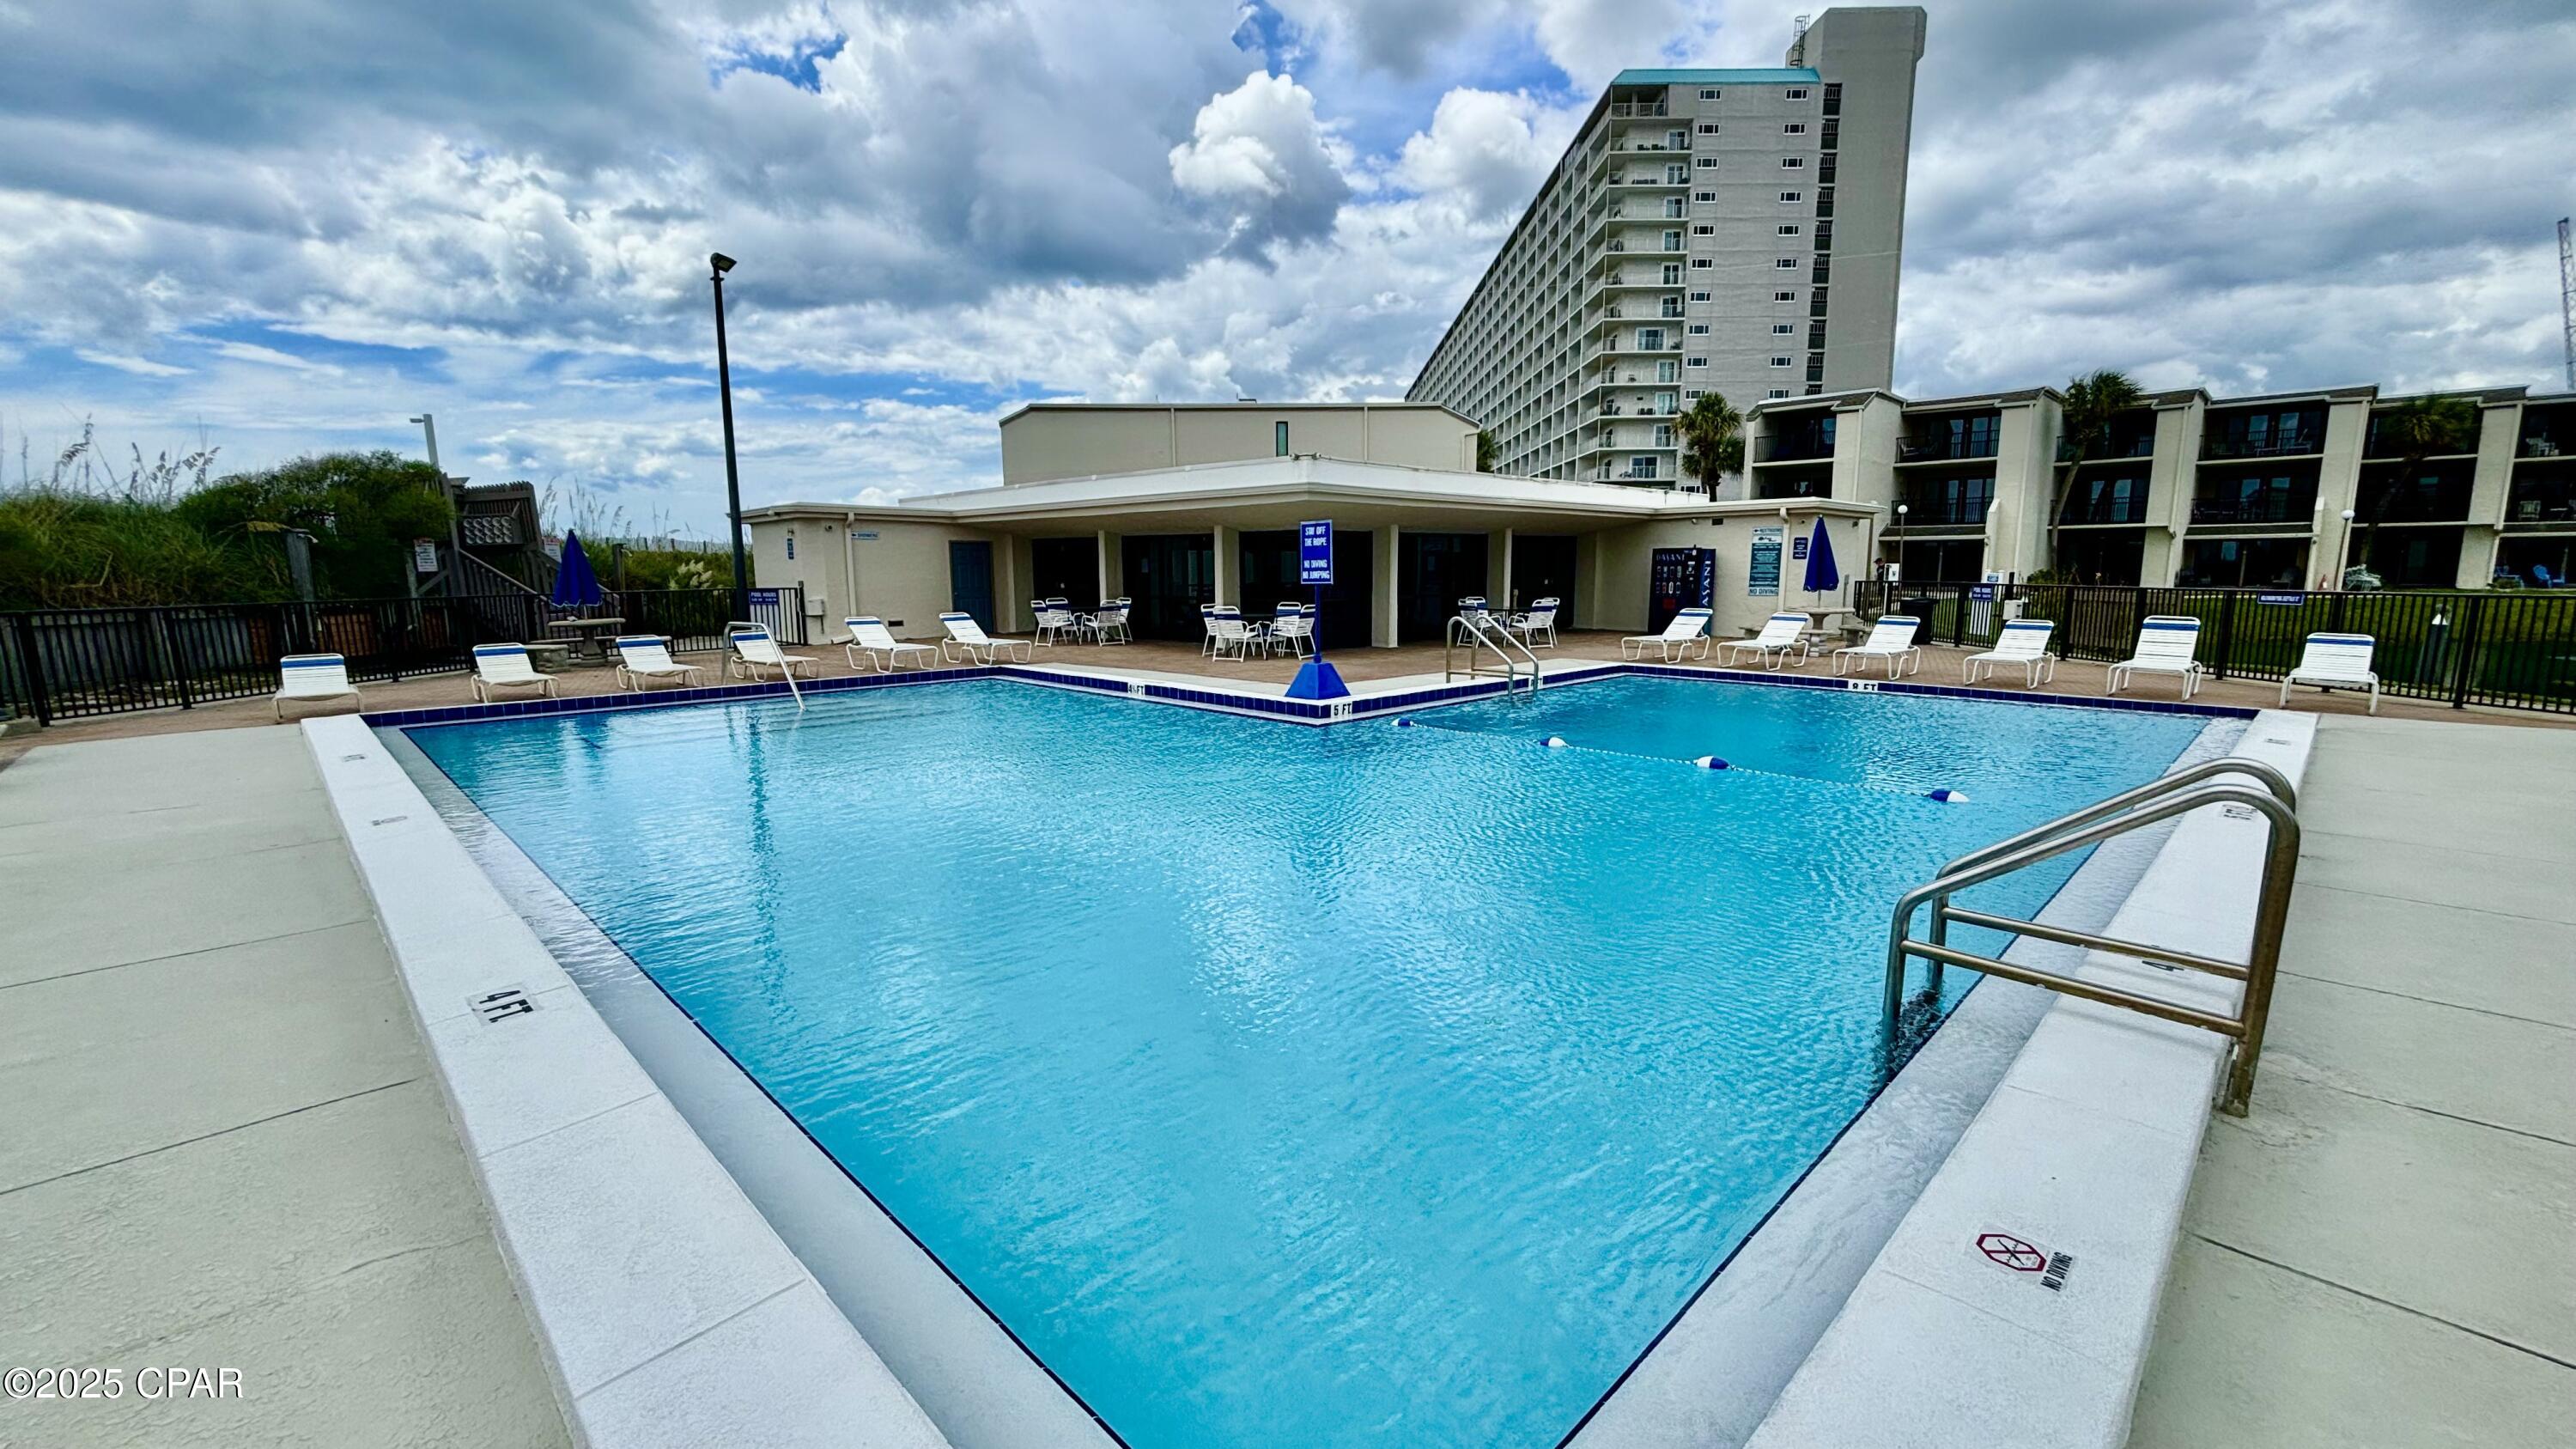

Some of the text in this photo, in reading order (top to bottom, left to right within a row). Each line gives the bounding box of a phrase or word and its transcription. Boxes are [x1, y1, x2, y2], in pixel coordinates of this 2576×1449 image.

[1305, 526, 1326, 535] STAY OFF
[1313, 537, 1327, 546] ROPE
[1311, 559, 1327, 569] DIVING
[1309, 570, 1330, 580] JUMPING
[1701, 560, 1711, 606] ASANI
[1334, 704, 1340, 716] 5
[478, 989, 521, 1005] 4
[2040, 1251, 2073, 1292] NO DIVING
